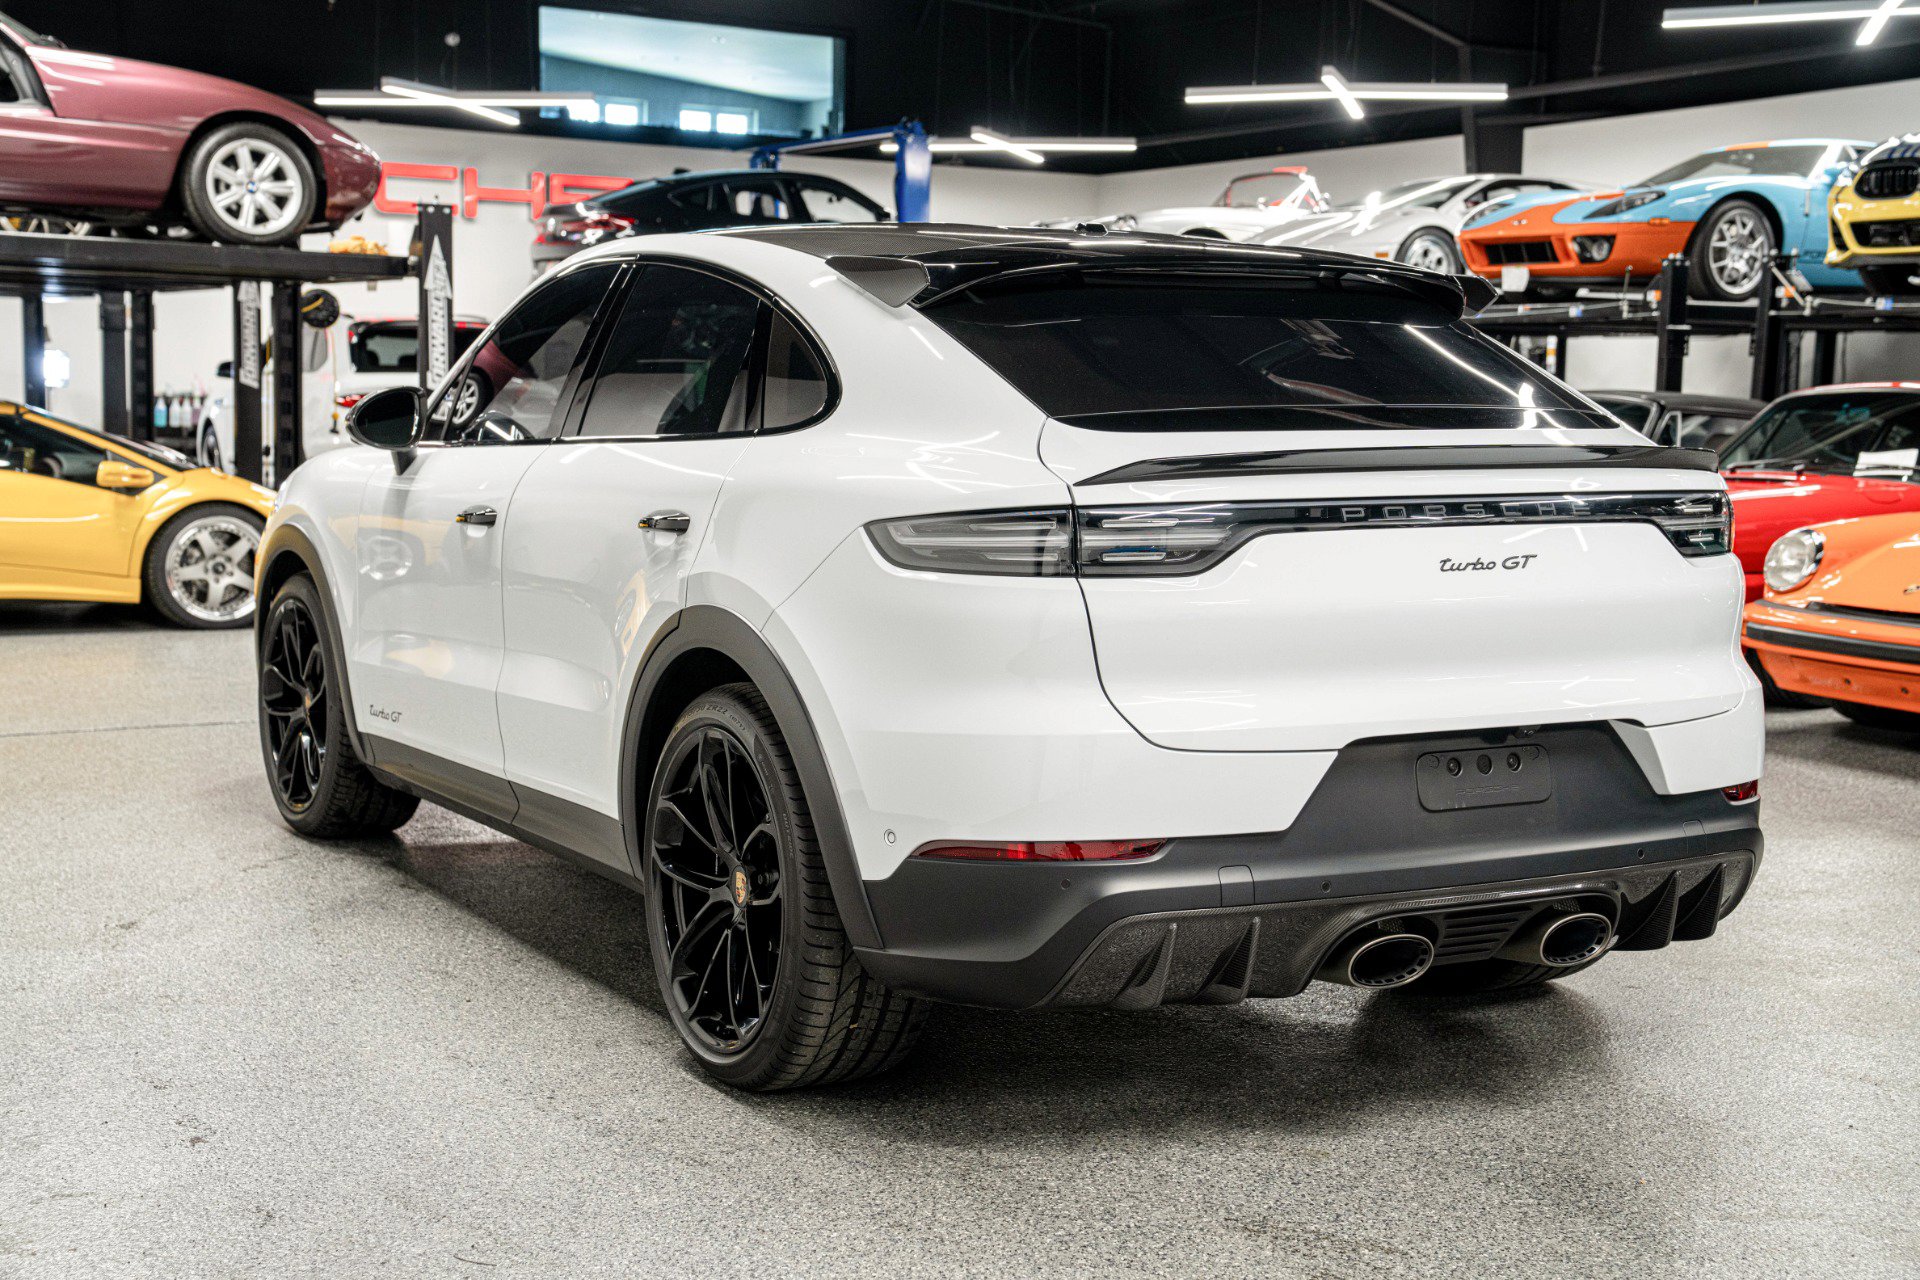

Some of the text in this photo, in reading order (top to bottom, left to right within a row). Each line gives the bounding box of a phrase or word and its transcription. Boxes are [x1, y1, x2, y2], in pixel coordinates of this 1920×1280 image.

[1340, 502, 1592, 523] PORSCHE
[1501, 554, 1538, 570] GT
[390, 711, 403, 724] GT
